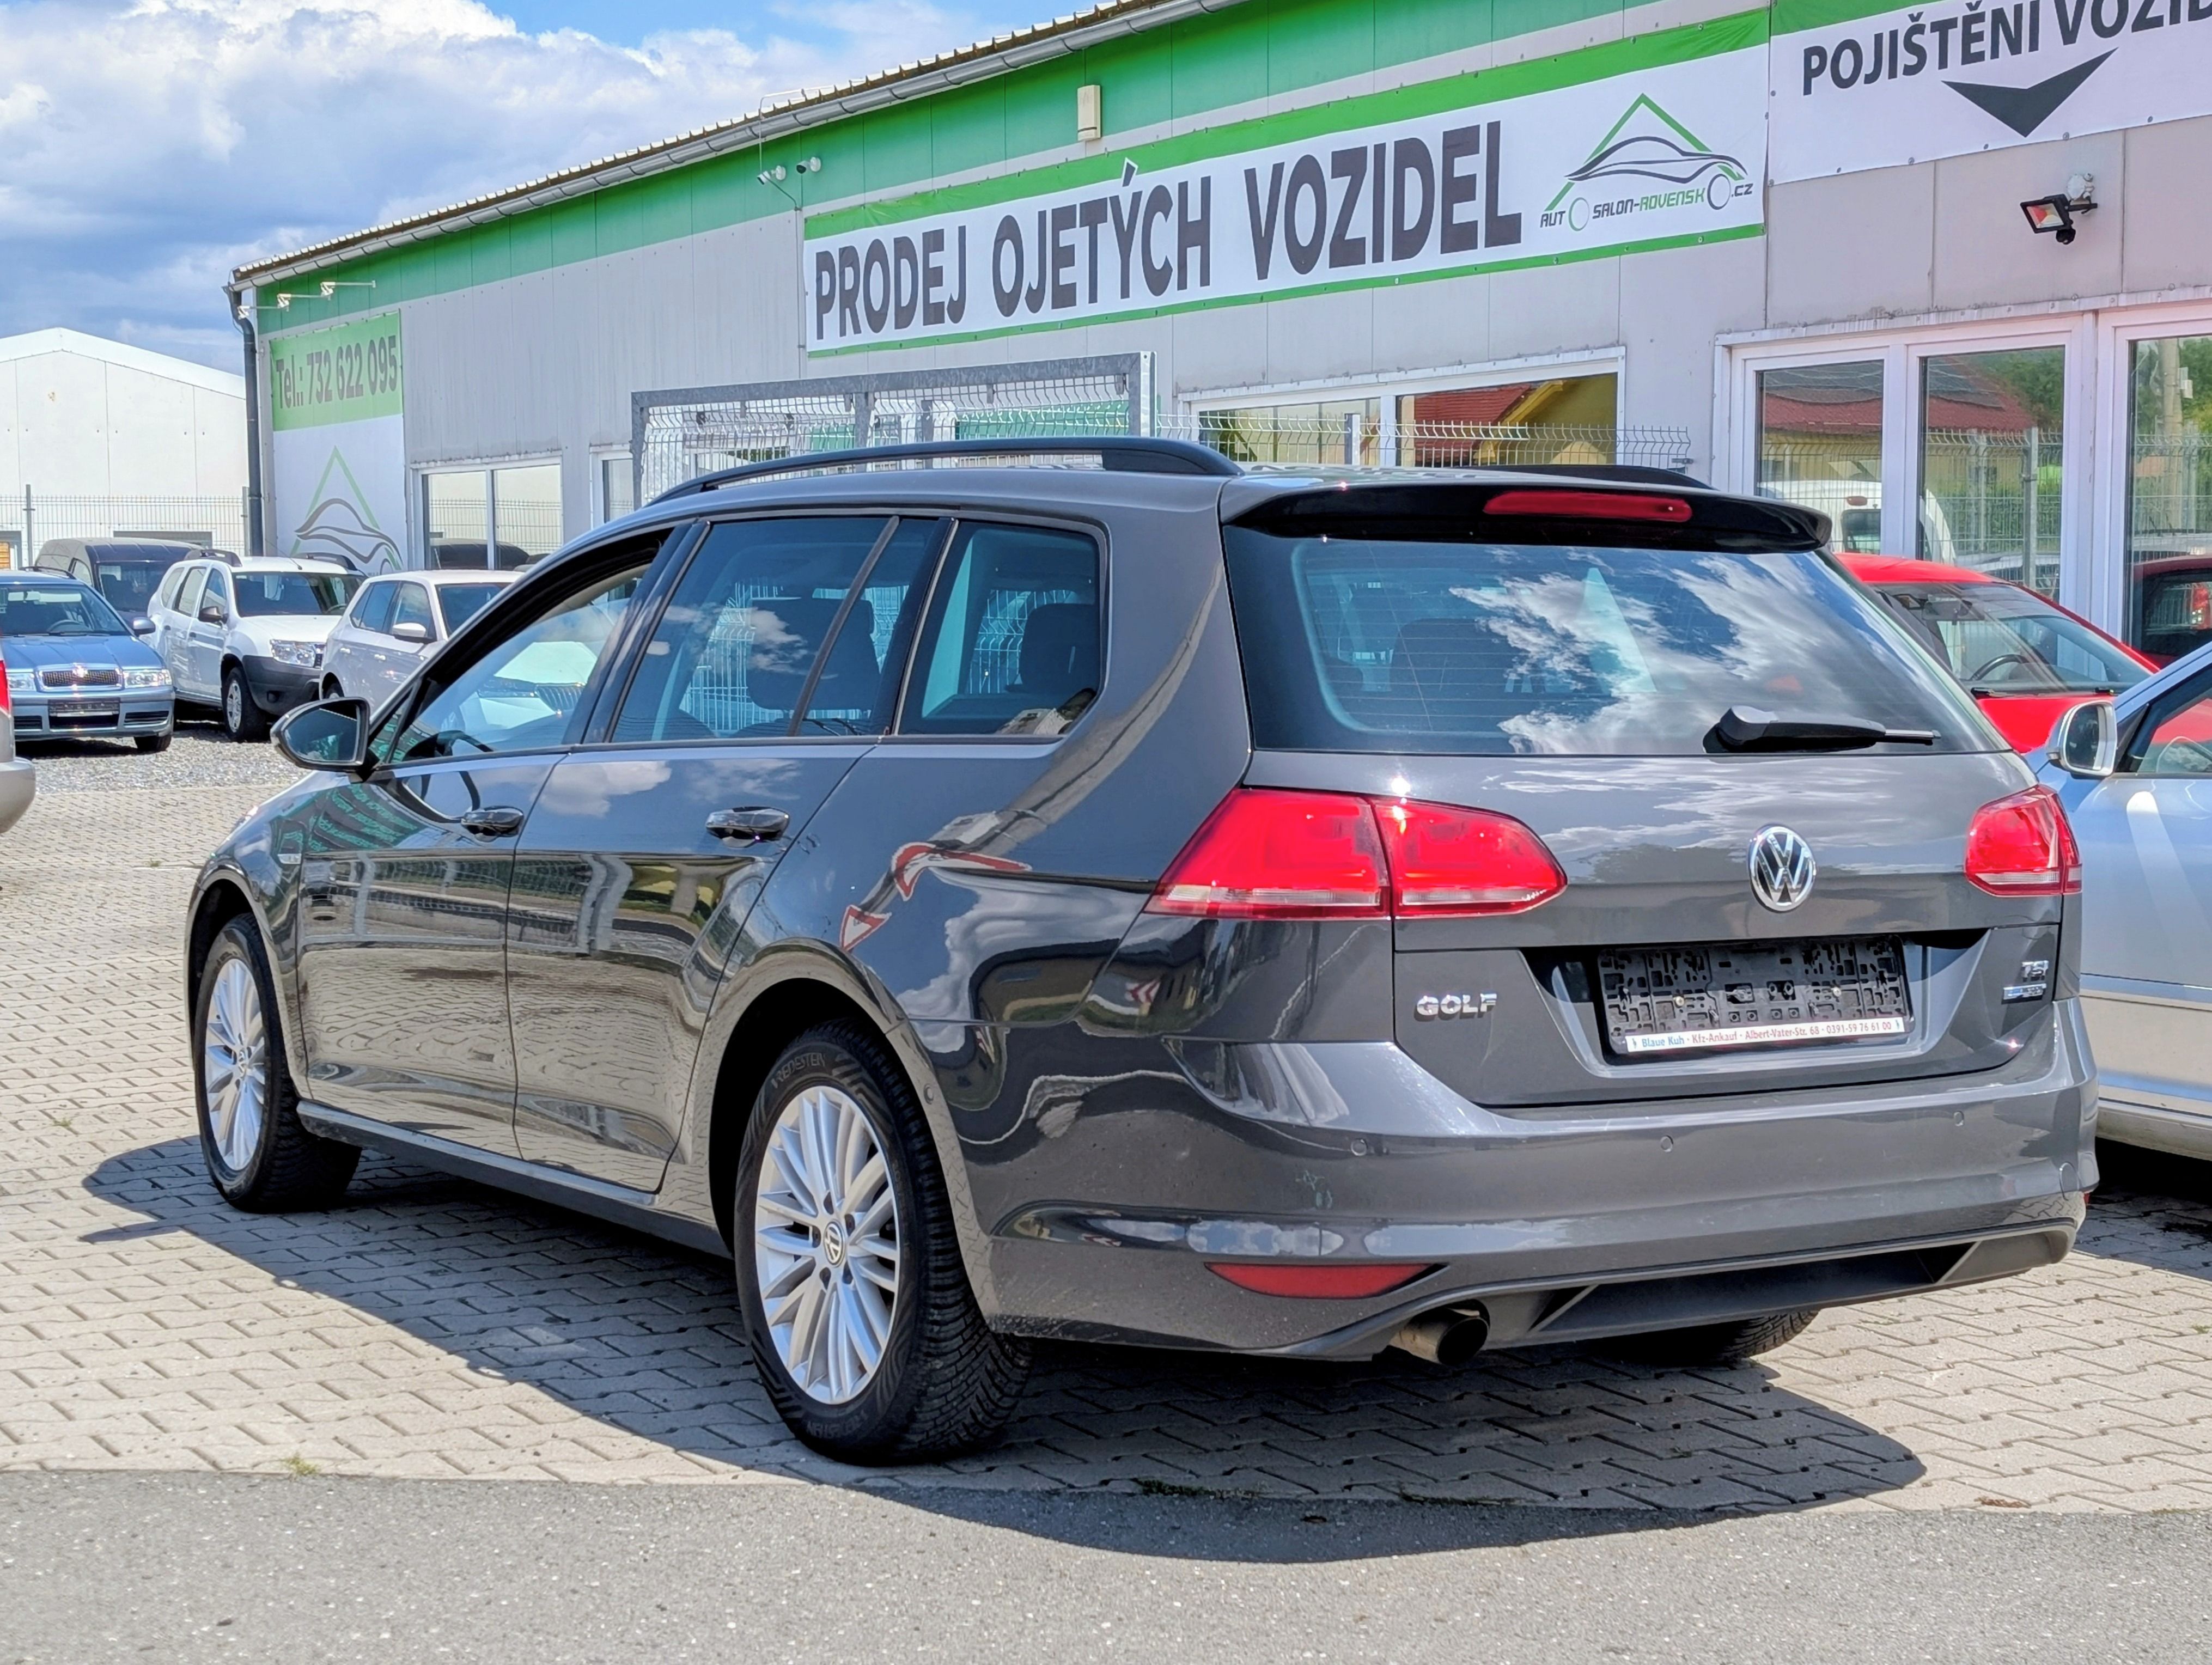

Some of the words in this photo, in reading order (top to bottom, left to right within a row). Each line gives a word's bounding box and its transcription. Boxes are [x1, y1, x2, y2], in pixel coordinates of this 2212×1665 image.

[815, 225, 967, 340] PRODEJ
[992, 159, 1211, 318] OJETÝCH
[1244, 120, 1522, 281] VOZIDEL
[276, 355, 304, 409] Tel.:
[307, 349, 333, 405] 732
[336, 343, 364, 401] 622
[368, 335, 398, 396] 095
[1416, 993, 1497, 1016] GOLF
[1642, 1038, 1665, 1048] Blaue
[1668, 1035, 1685, 1046] Kuh
[1691, 1031, 1738, 1044] Kfz-Ankauf
[1809, 1026, 1819, 1035] 68
[1860, 1023, 1869, 1032] 76
[1871, 1022, 1879, 1030] 61
[1882, 1021, 1892, 1030] 00
